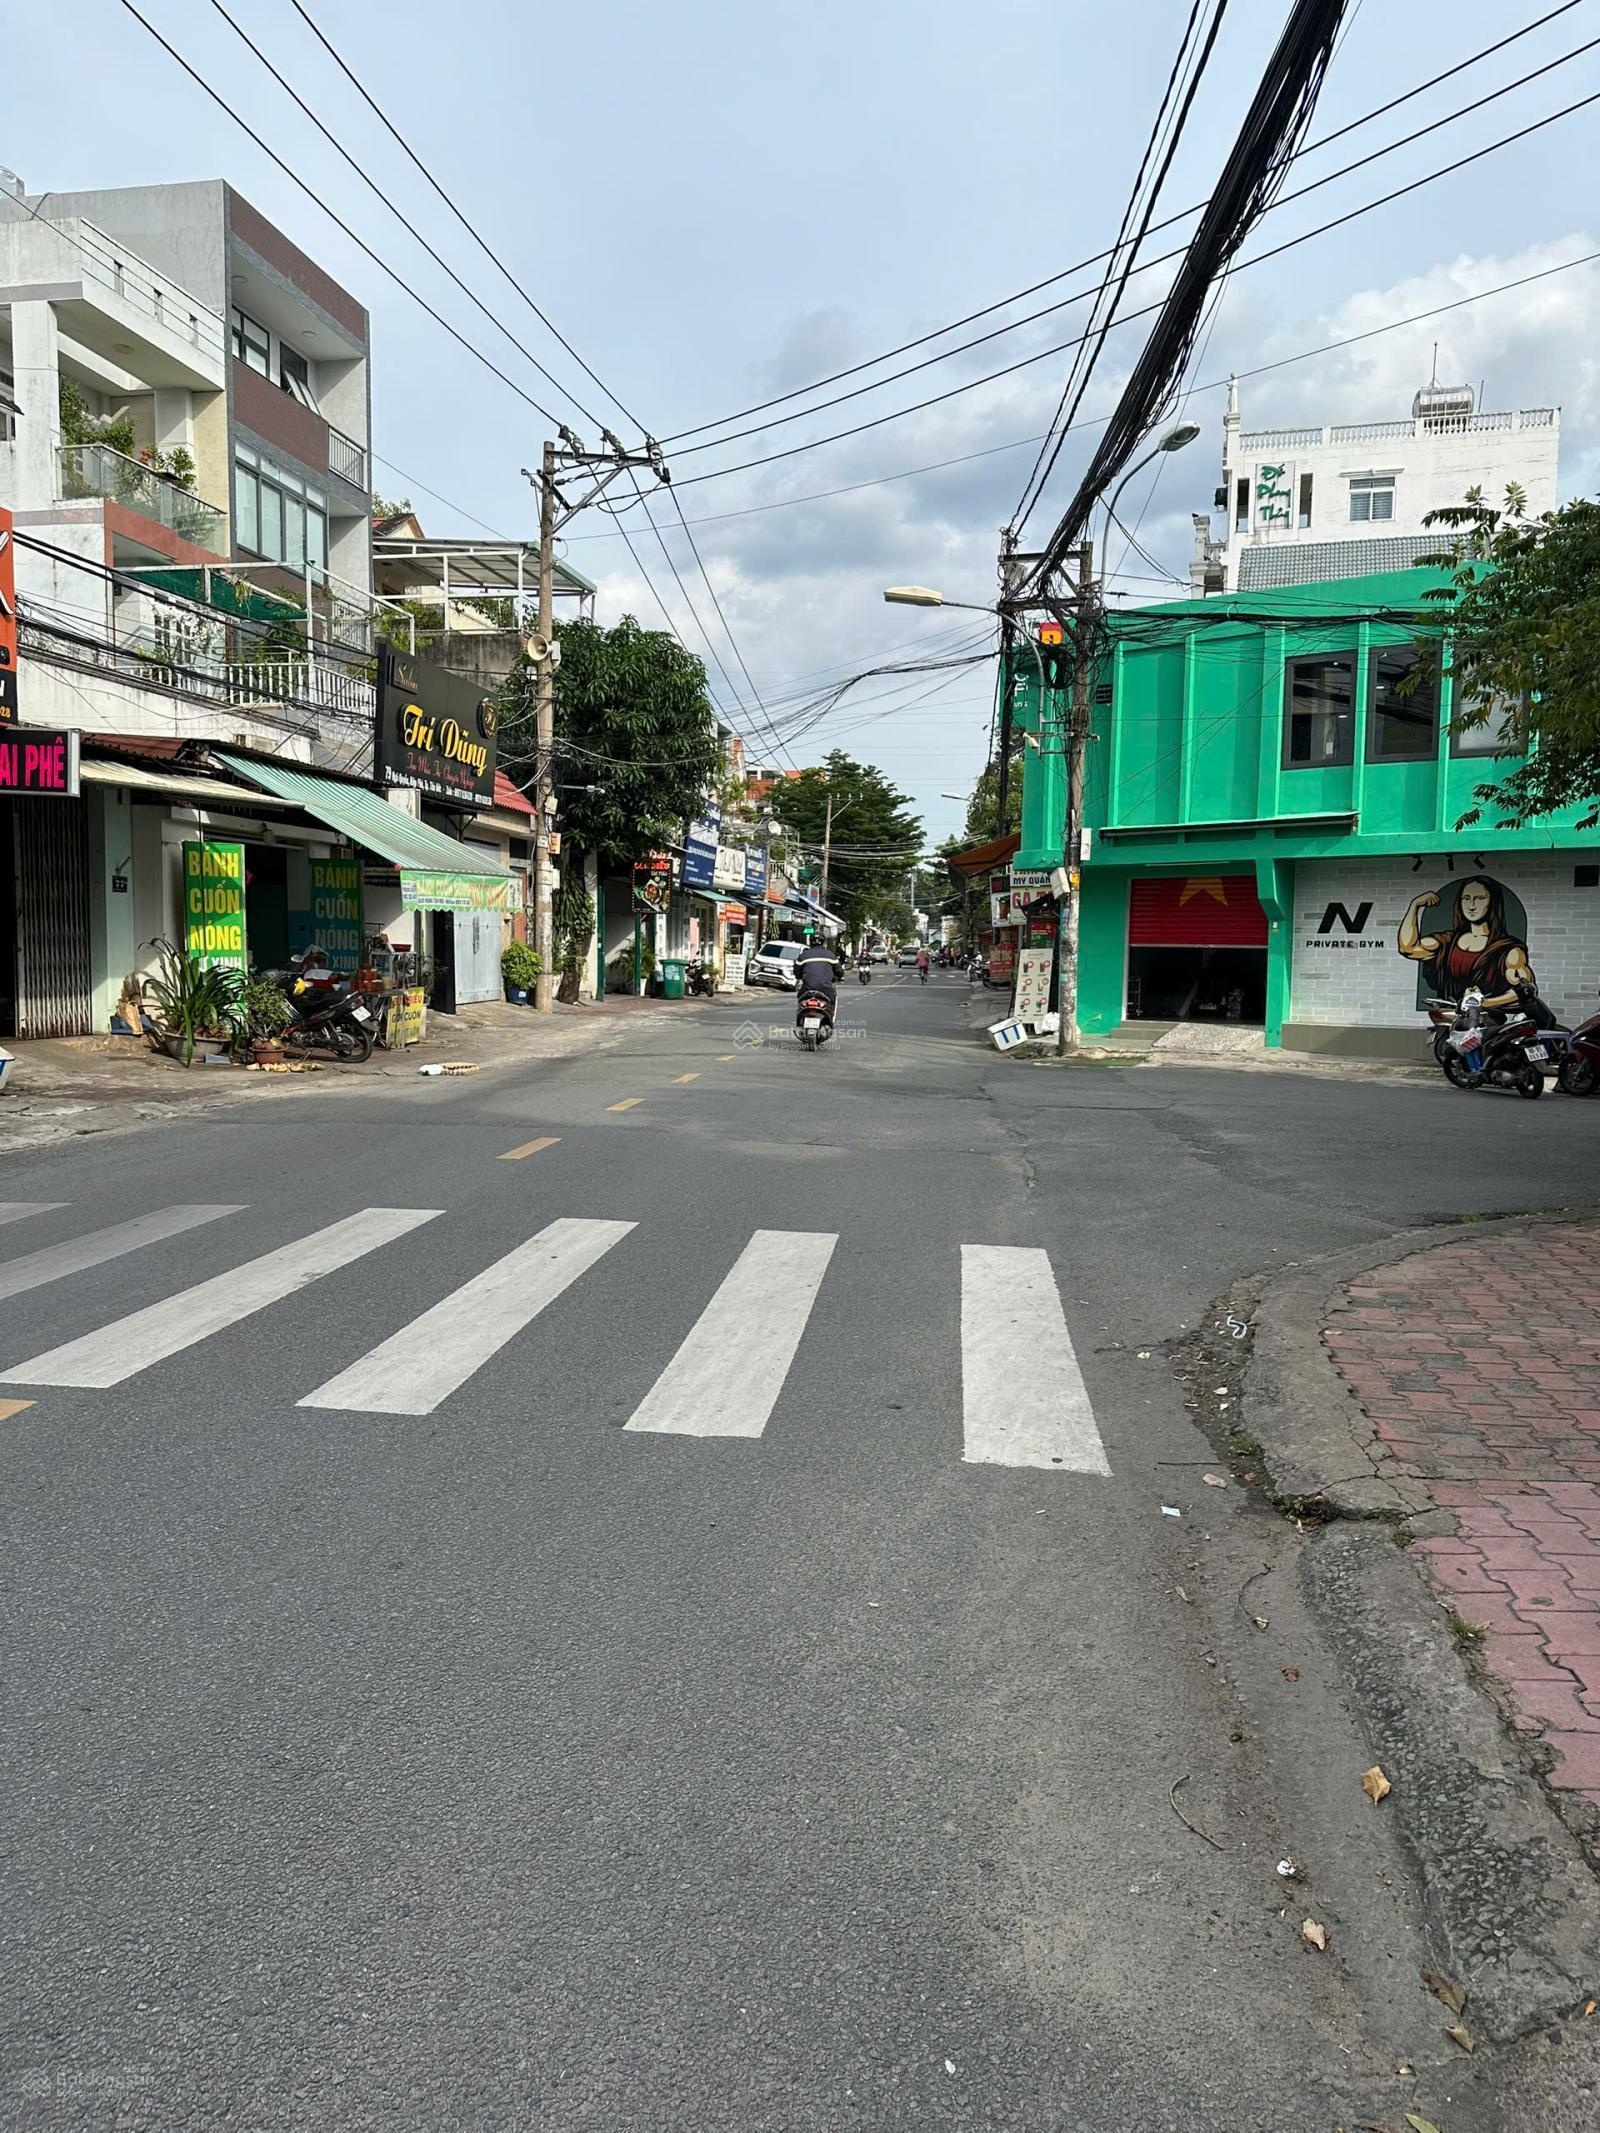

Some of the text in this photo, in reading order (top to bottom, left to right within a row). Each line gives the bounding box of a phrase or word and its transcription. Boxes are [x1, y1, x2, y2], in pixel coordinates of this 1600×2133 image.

[1257, 481, 1291, 508] Phong
[403, 703, 435, 752] Trí
[440, 718, 487, 777] Dũng
[25, 737, 65, 788] PHÊ
[188, 845, 239, 878] BÁNH
[315, 864, 358, 889] BÁNH
[189, 880, 240, 914] CUỐN
[315, 892, 358, 919] CUỐN
[1317, 902, 1374, 934] N
[190, 921, 242, 951] NÓNG
[315, 924, 358, 951] NÓNG
[1306, 940, 1384, 948] PRIVATE GYM
[332, 955, 359, 970] XINH
